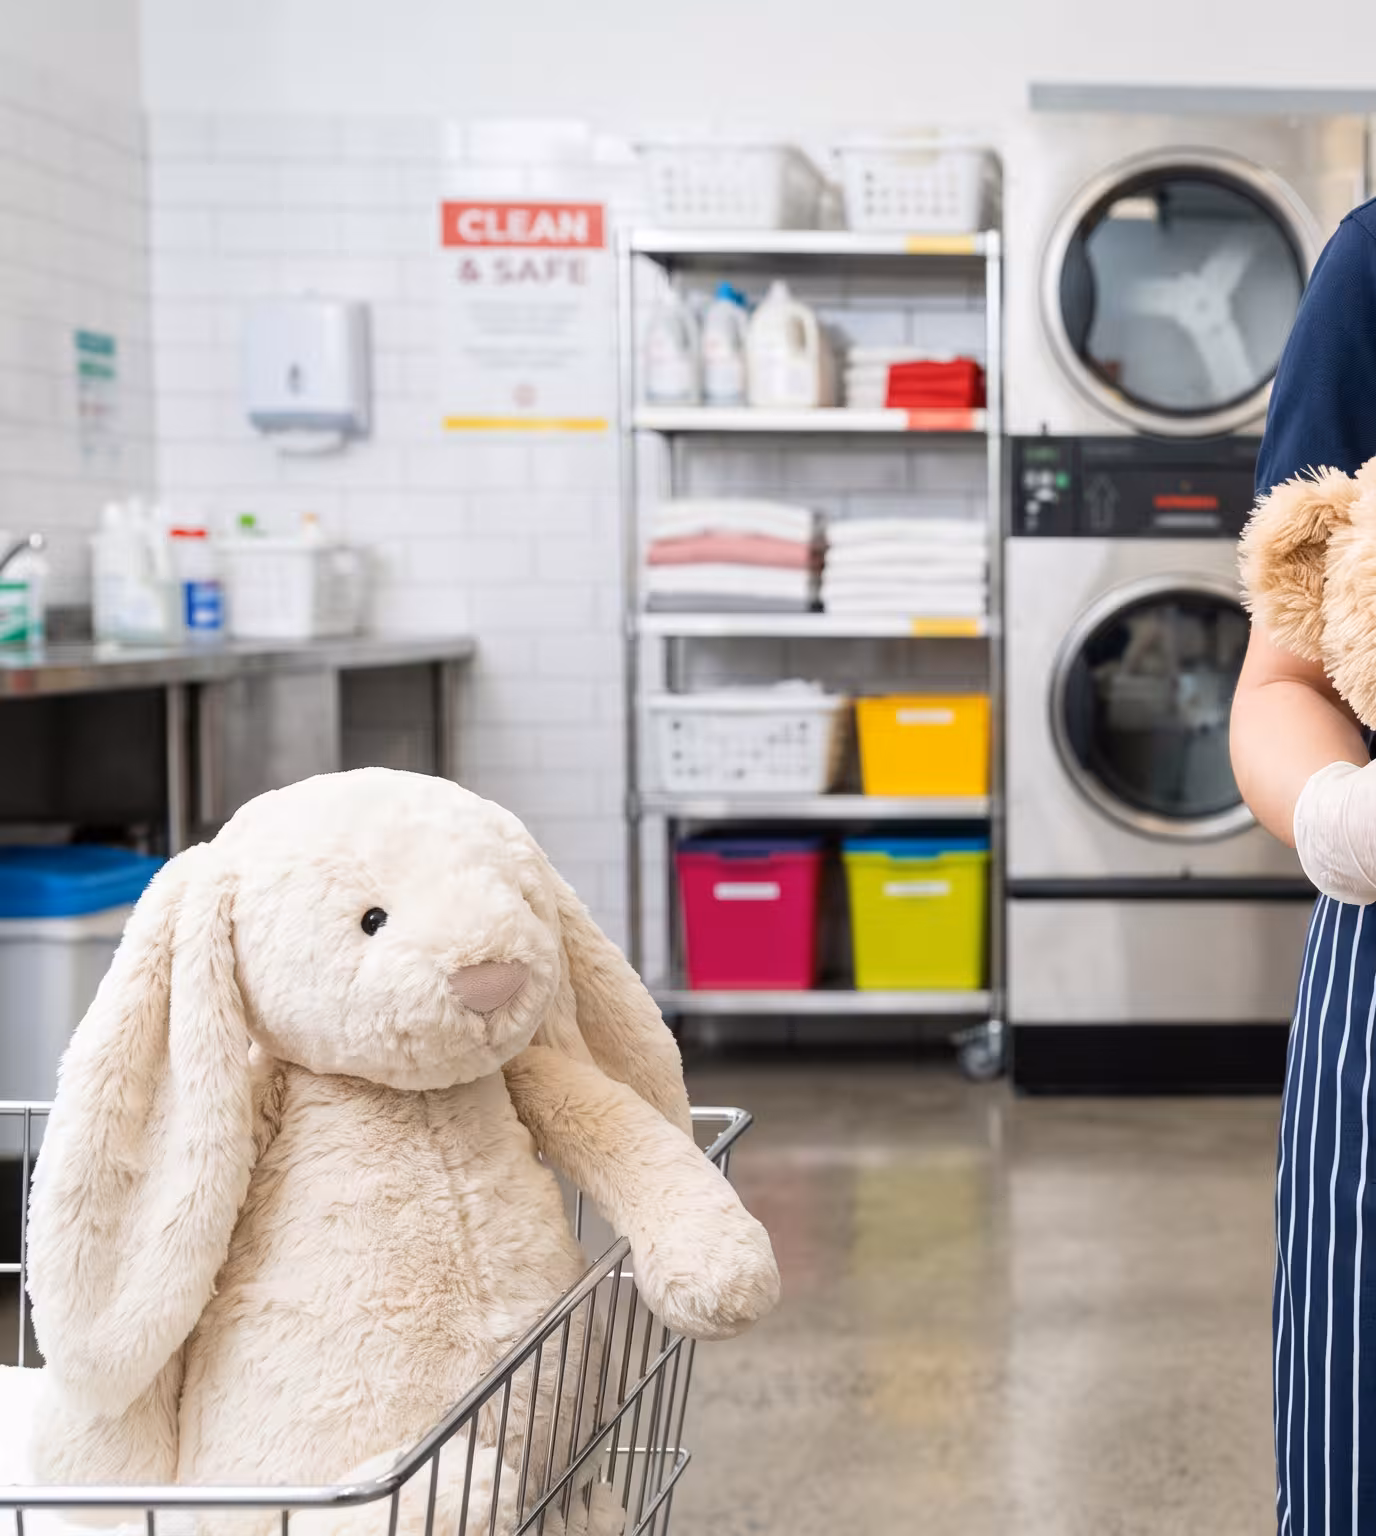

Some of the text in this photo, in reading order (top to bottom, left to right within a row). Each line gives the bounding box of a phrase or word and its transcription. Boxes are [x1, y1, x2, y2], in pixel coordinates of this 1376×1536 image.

[457, 208, 589, 244] CLEAN
[458, 257, 588, 285] & SAFE
